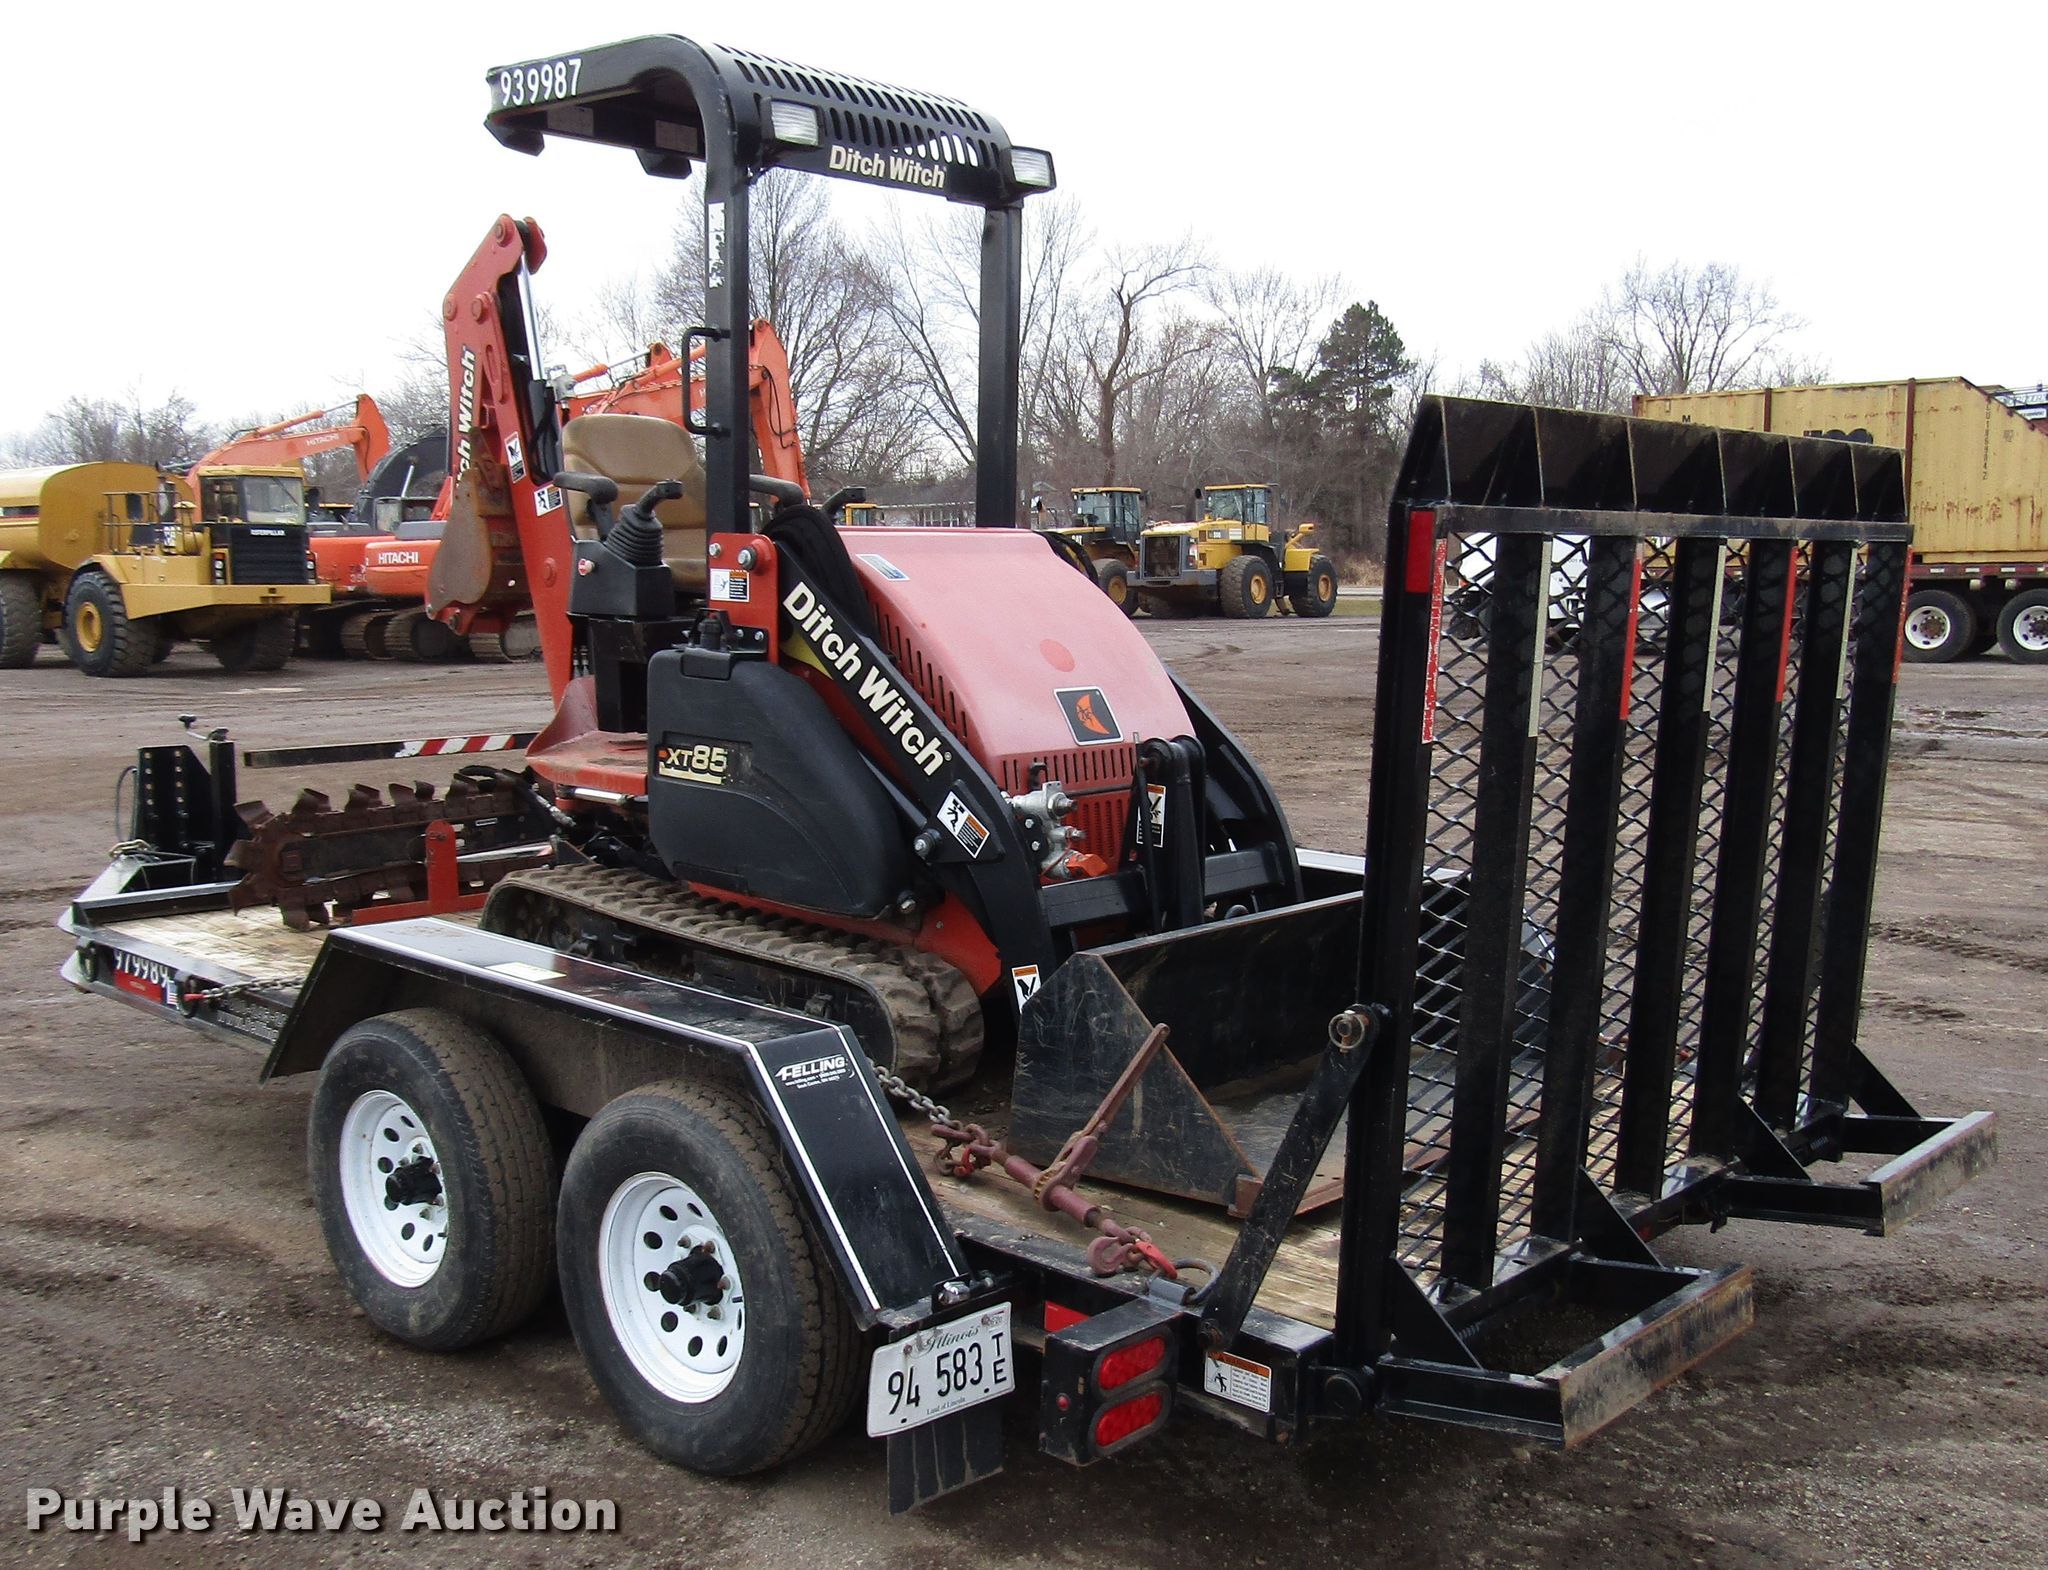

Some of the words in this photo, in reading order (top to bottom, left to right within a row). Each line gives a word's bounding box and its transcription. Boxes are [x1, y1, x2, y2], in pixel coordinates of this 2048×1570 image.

[501, 58, 582, 106] 939987
[829, 144, 886, 178] Ditch
[889, 155, 946, 188] Witch
[458, 349, 476, 433] Witch
[378, 551, 419, 564] HITACHI
[782, 581, 862, 681] Ditch
[858, 665, 944, 777] Witch
[665, 744, 728, 773] XT85
[775, 1055, 846, 1081] FELLING
[924, 1325, 980, 1353] Illinois
[887, 1365, 921, 1415] 94
[936, 1342, 983, 1397] 583
